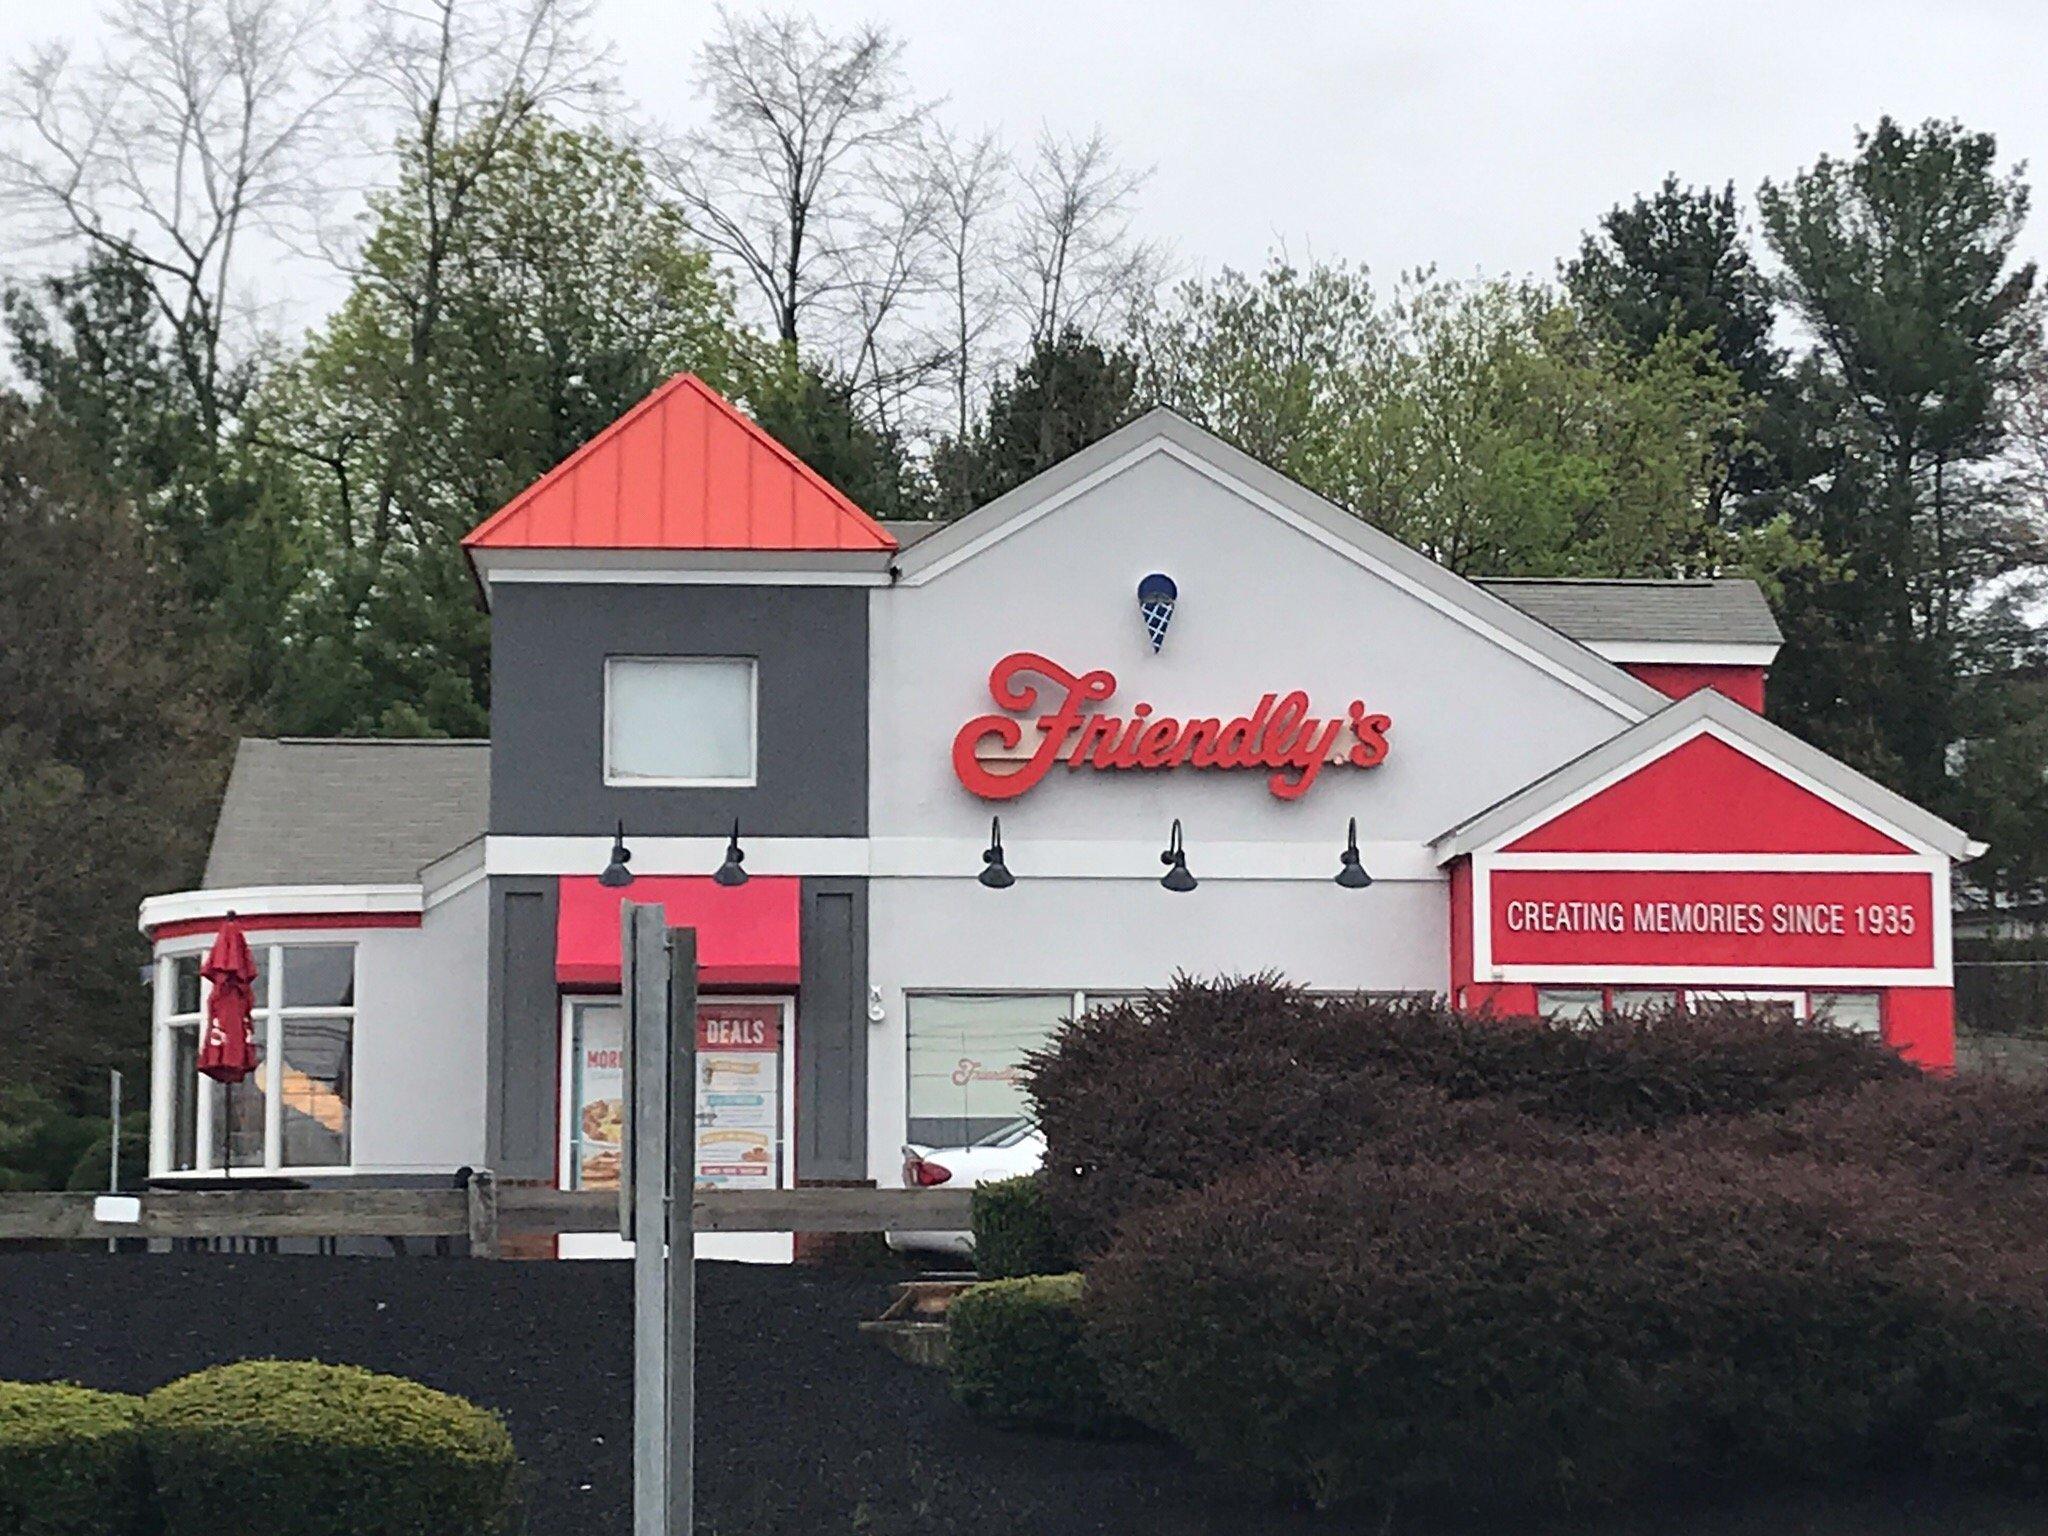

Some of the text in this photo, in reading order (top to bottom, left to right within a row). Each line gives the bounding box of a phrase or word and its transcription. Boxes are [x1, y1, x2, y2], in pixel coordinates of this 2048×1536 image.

[952, 651, 1391, 800] Friendly's
[1507, 900, 1916, 935] CREATING MEMORIES SINCE 1935
[706, 1019, 765, 1044] DEALS
